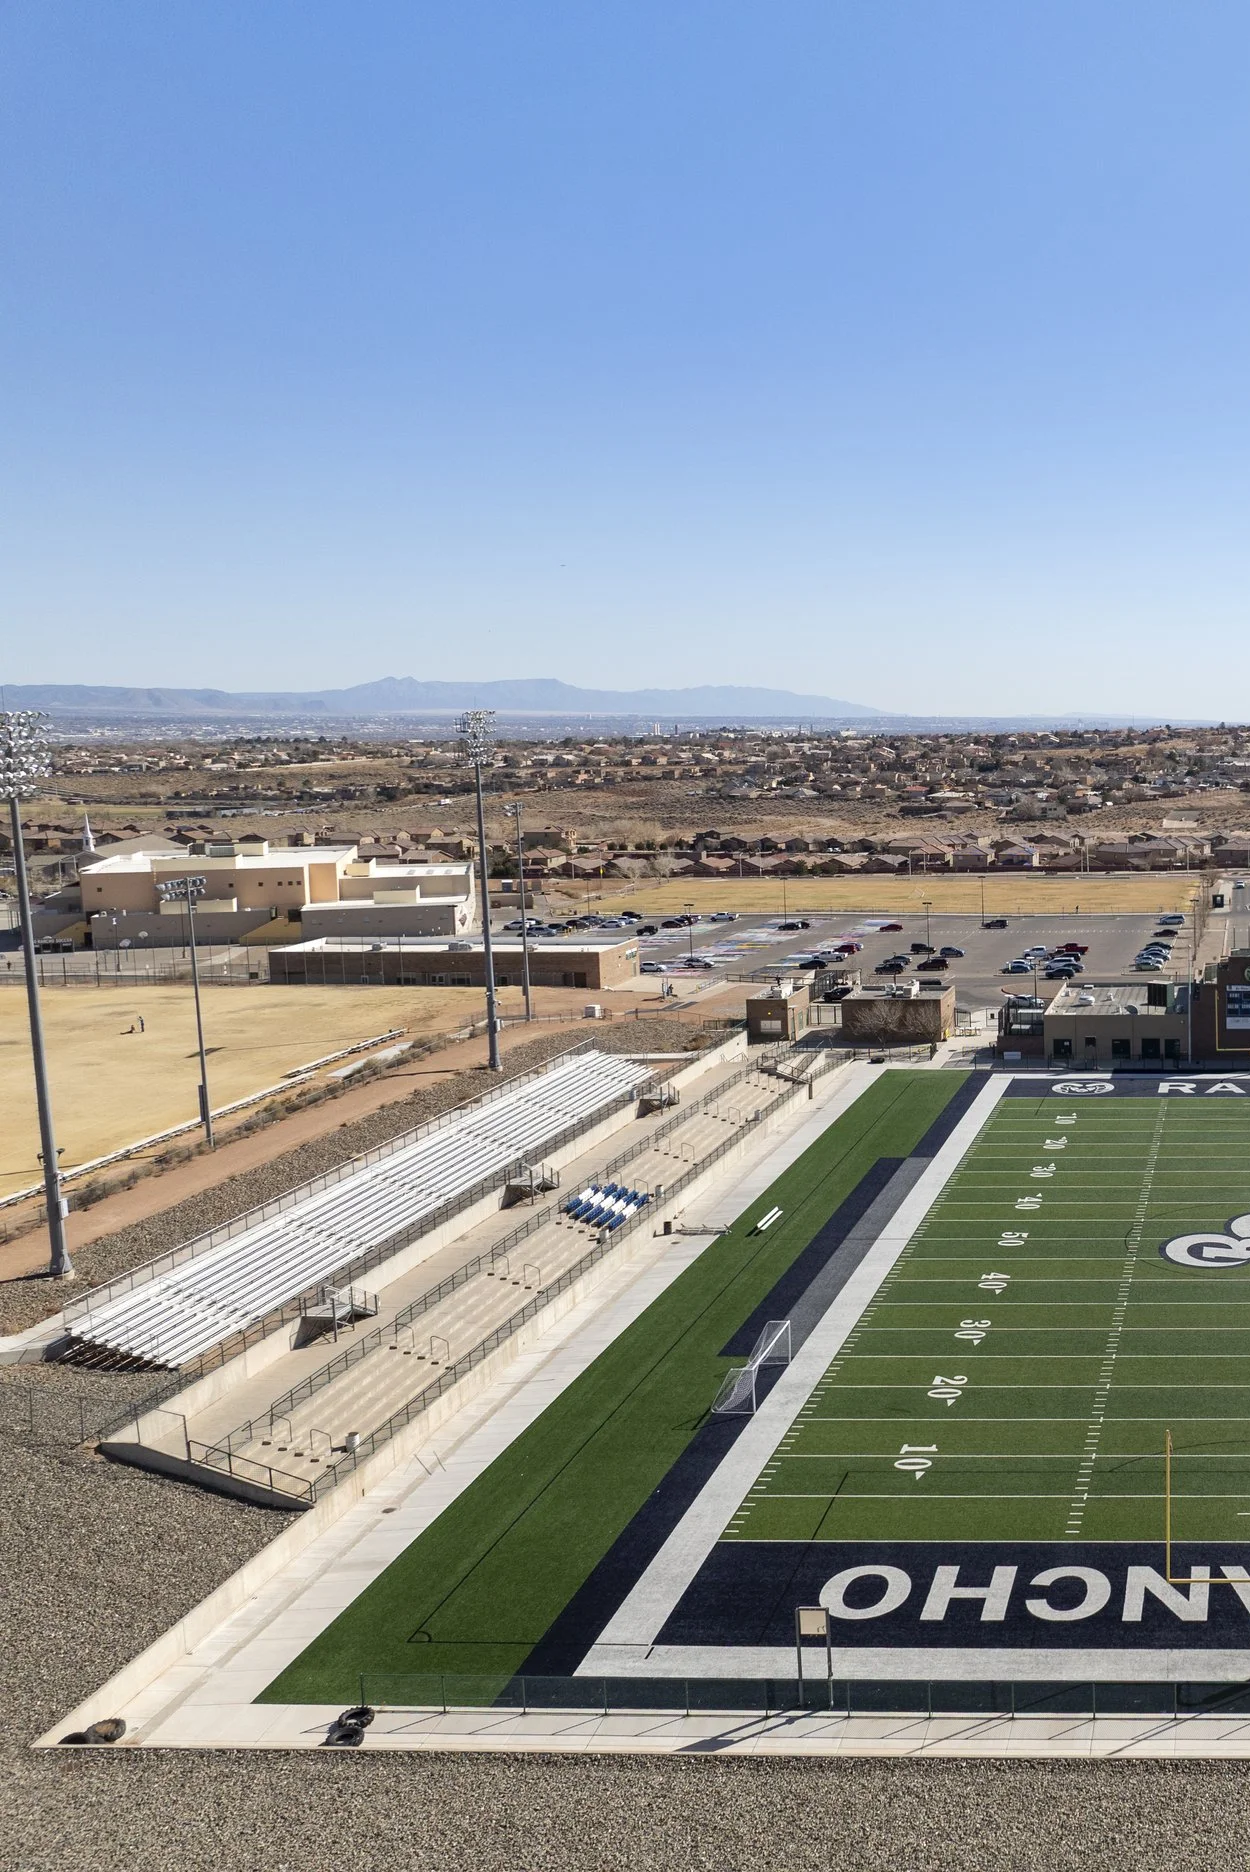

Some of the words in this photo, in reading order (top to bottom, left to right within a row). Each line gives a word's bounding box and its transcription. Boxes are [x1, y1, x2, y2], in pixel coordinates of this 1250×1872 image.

[1054, 1114, 1077, 1125] 10
[1042, 1138, 1067, 1150] 20
[1030, 1165, 1056, 1178] 30
[1014, 1196, 1042, 1210] 40
[998, 1231, 1028, 1247] 50
[978, 1272, 1010, 1289] 40
[954, 1319, 991, 1339] 30
[927, 1375, 968, 1399] 20
[894, 1443, 938, 1470] 10
